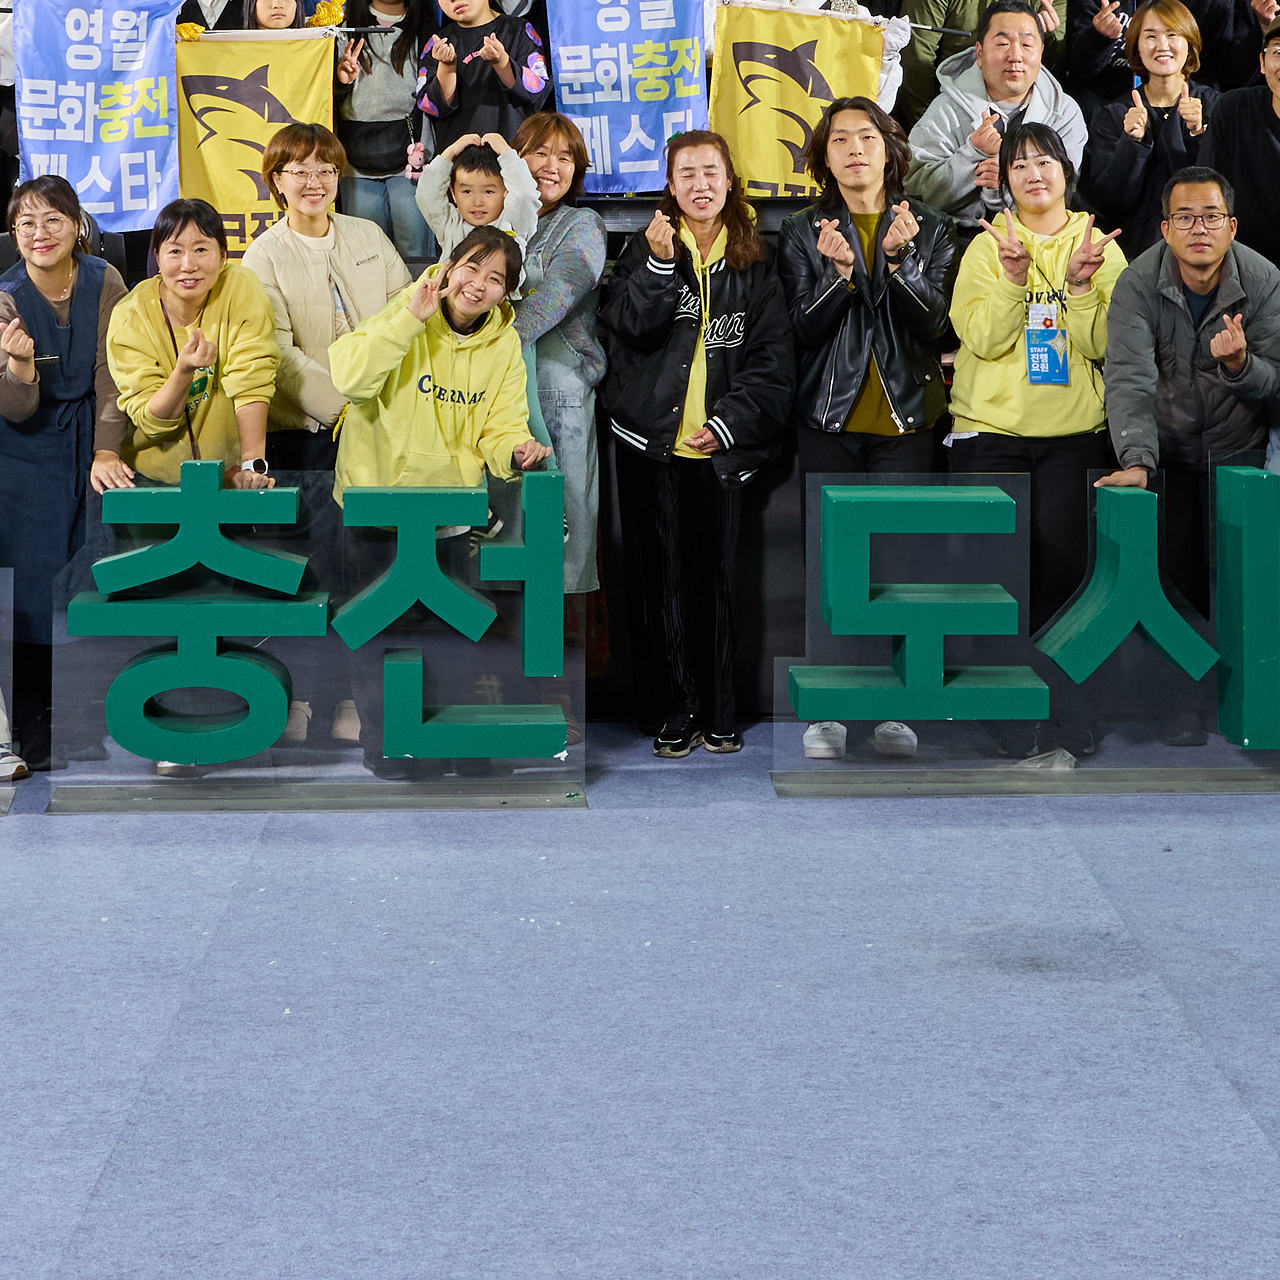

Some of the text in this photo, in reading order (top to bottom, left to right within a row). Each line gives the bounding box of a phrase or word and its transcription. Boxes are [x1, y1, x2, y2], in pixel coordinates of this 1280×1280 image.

[65, 7, 149, 71] 영월
[558, 36, 701, 105] 문화충전
[19, 75, 169, 144] 문화충전
